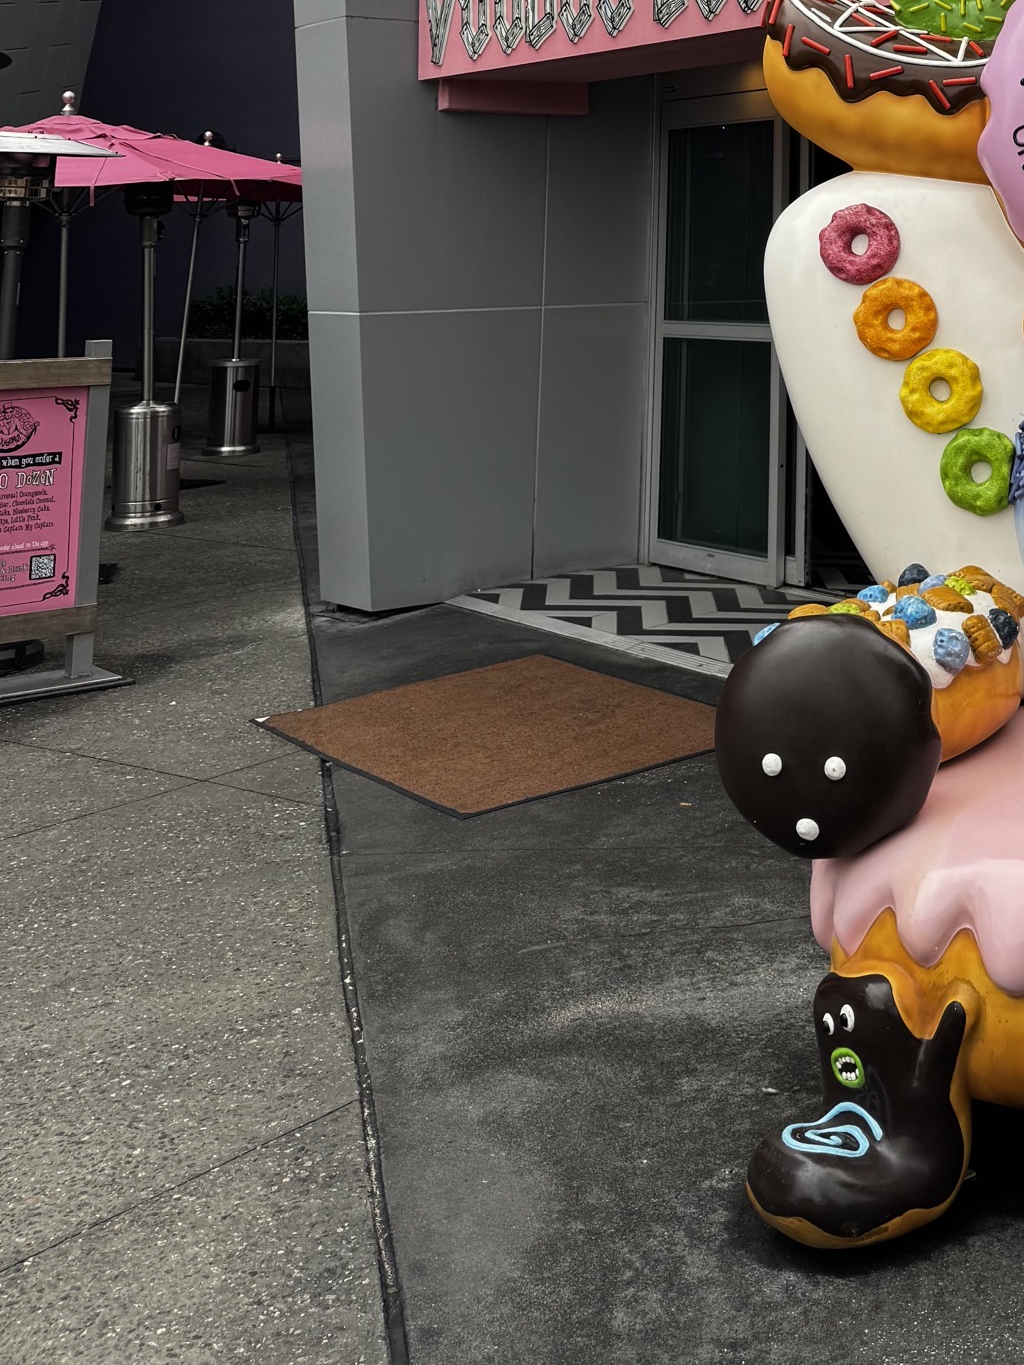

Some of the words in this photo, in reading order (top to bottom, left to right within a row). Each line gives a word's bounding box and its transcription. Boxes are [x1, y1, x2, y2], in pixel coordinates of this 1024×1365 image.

[1, 457, 19, 467] when
[21, 457, 34, 467] you
[35, 453, 53, 463] order
[54, 454, 60, 462] a
